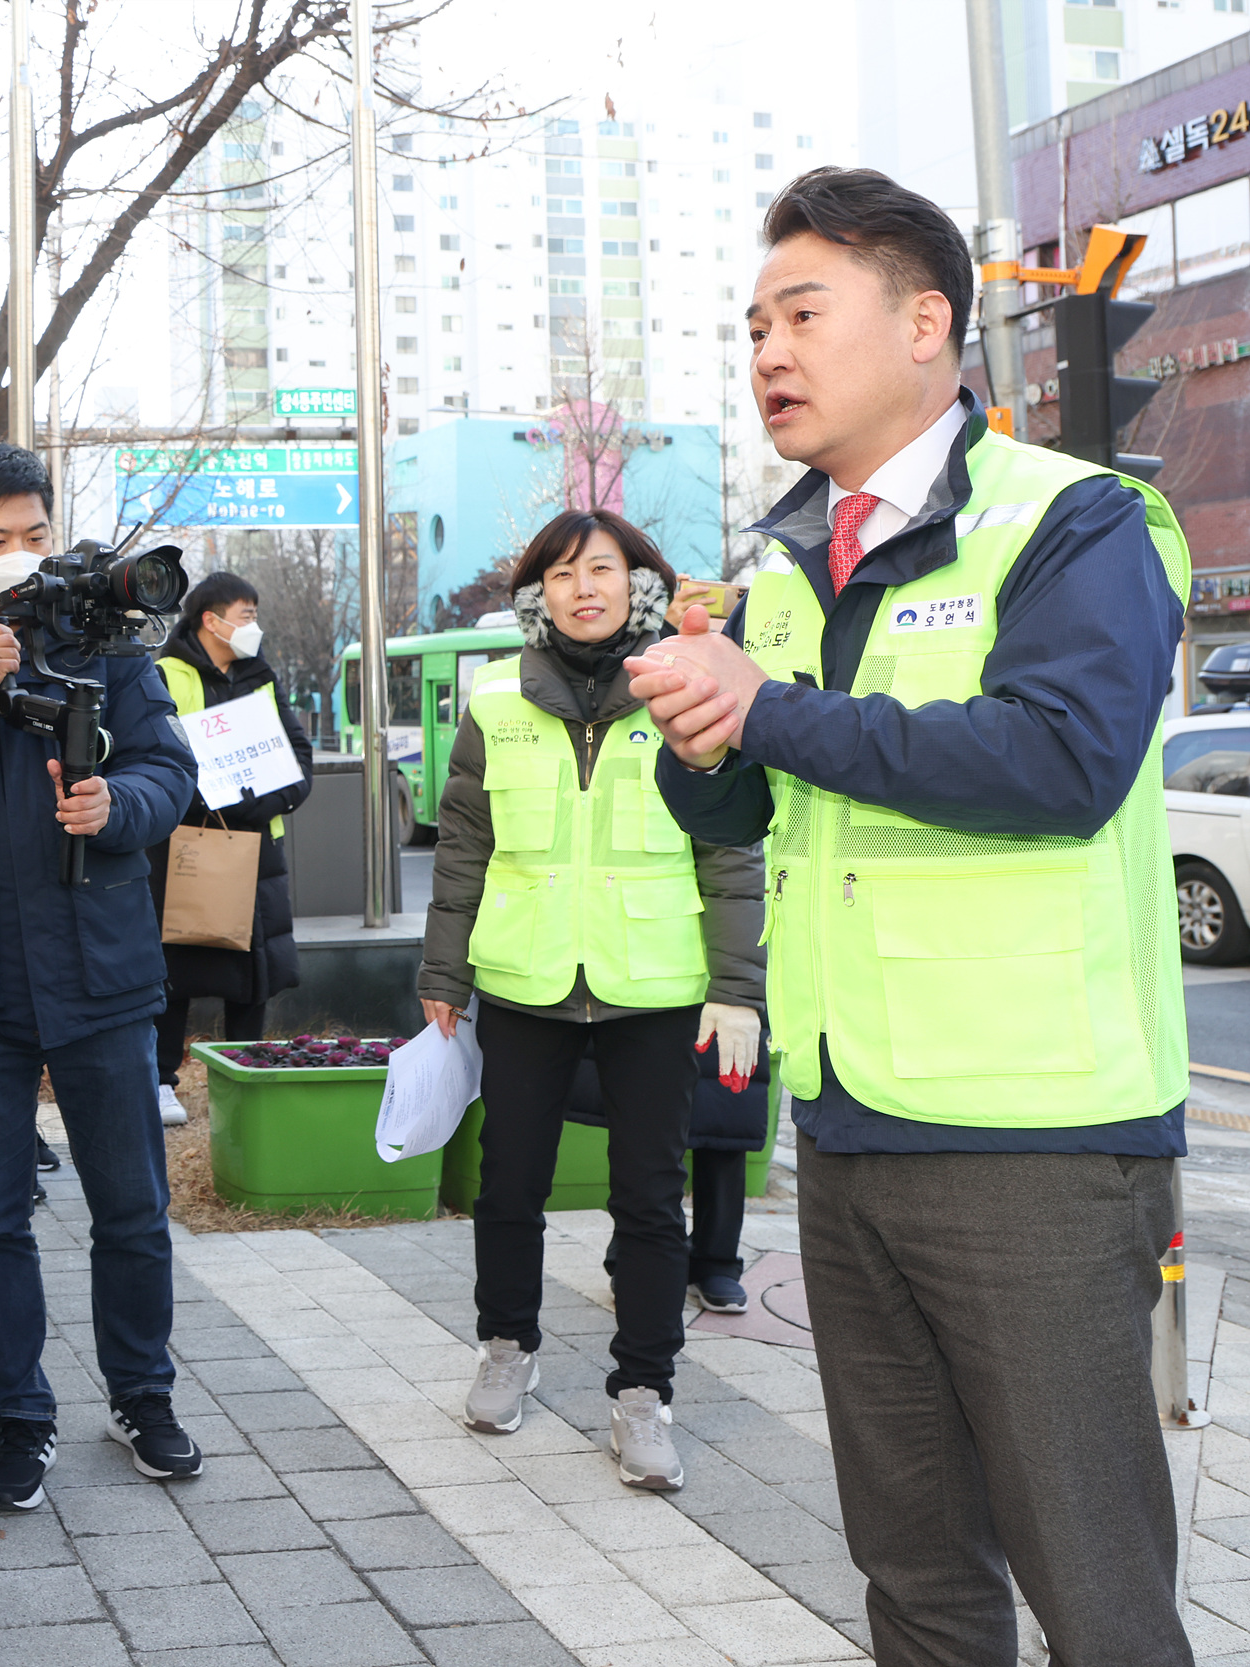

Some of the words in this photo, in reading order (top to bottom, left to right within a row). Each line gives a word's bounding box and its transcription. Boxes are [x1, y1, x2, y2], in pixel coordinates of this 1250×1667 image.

[214, 478, 279, 499] 노해로
[207, 502, 285, 518] Nohae-ro
[930, 598, 974, 612] 도봉구청장
[924, 611, 975, 627] 오언석
[200, 713, 232, 738] 2조
[522, 734, 539, 745] 도봉
